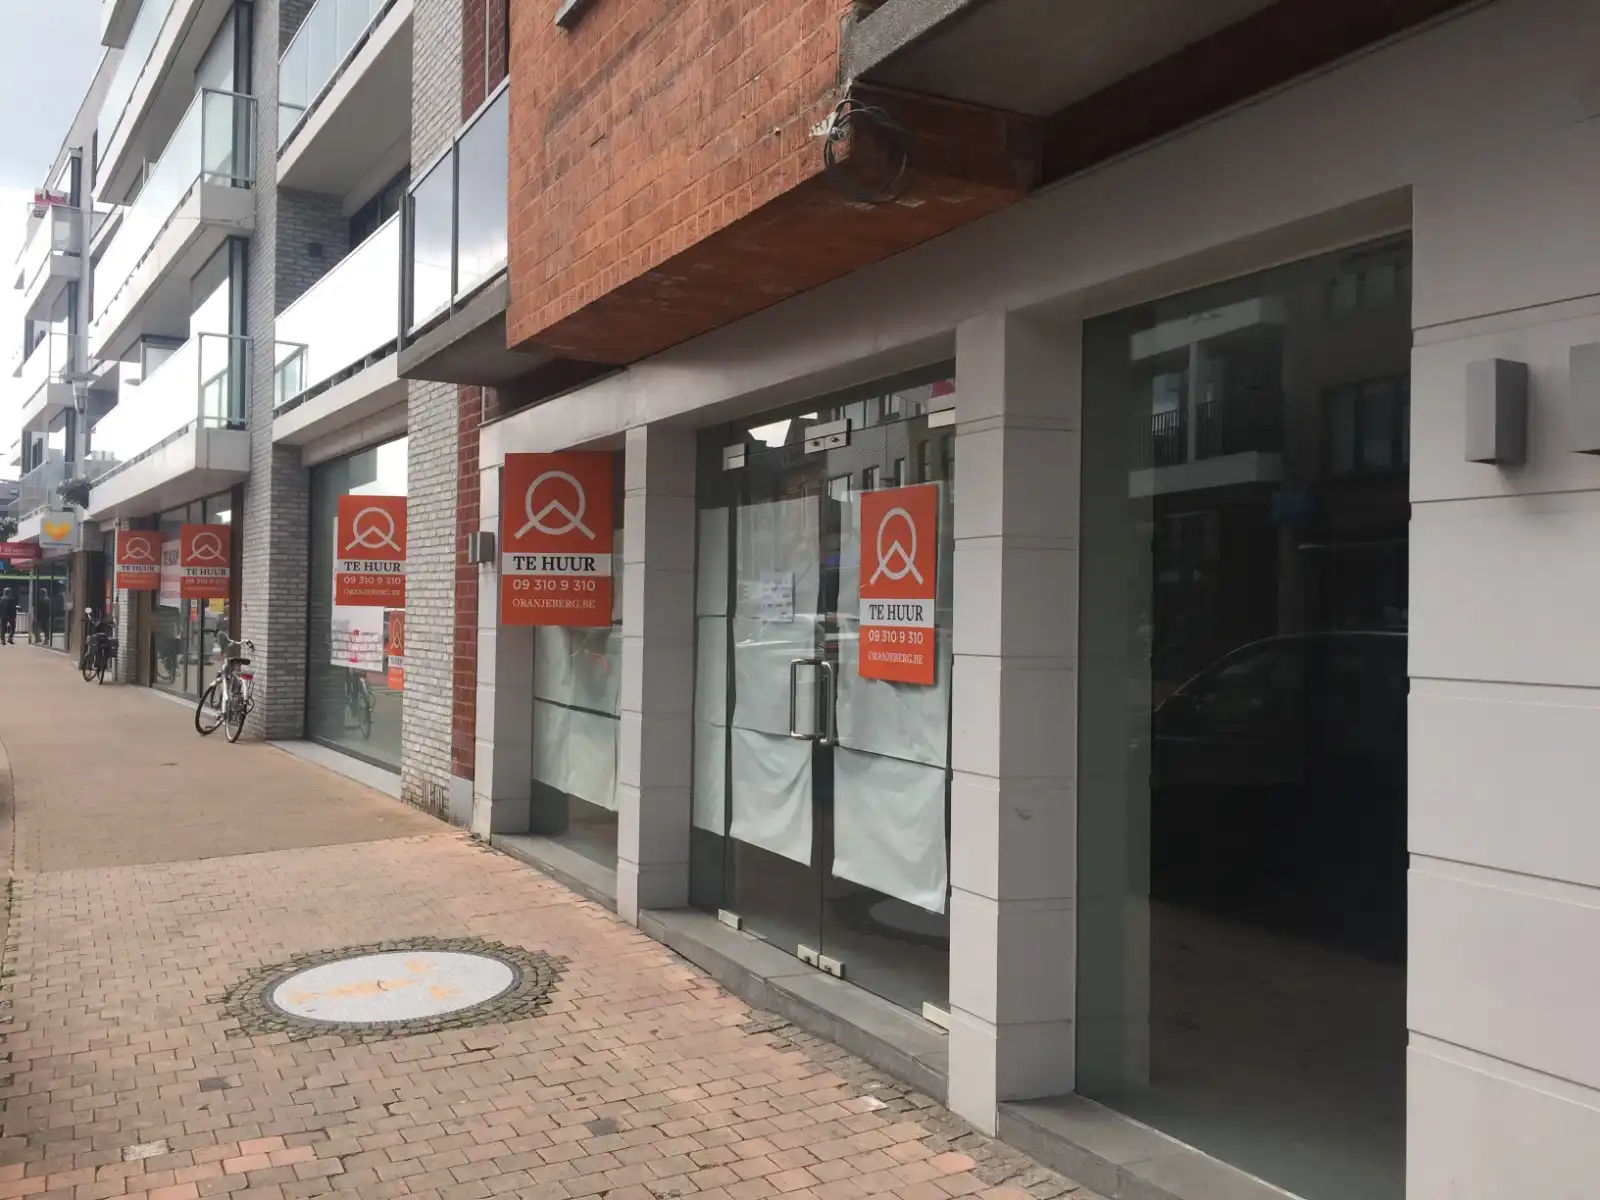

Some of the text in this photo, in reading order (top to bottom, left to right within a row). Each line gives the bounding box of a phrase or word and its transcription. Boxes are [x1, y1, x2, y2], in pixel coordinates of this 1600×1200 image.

[344, 561, 401, 572] TE HUUR
[513, 556, 596, 572] TE HUUR
[185, 567, 227, 577] TE HUUR
[344, 576, 401, 585] 09 310 9 310
[513, 579, 596, 592] 09 310 9 310
[512, 598, 596, 610] ORANJEBERG.BE
[869, 604, 924, 622] TE HUUR
[868, 629, 924, 645] 09 310 9 310
